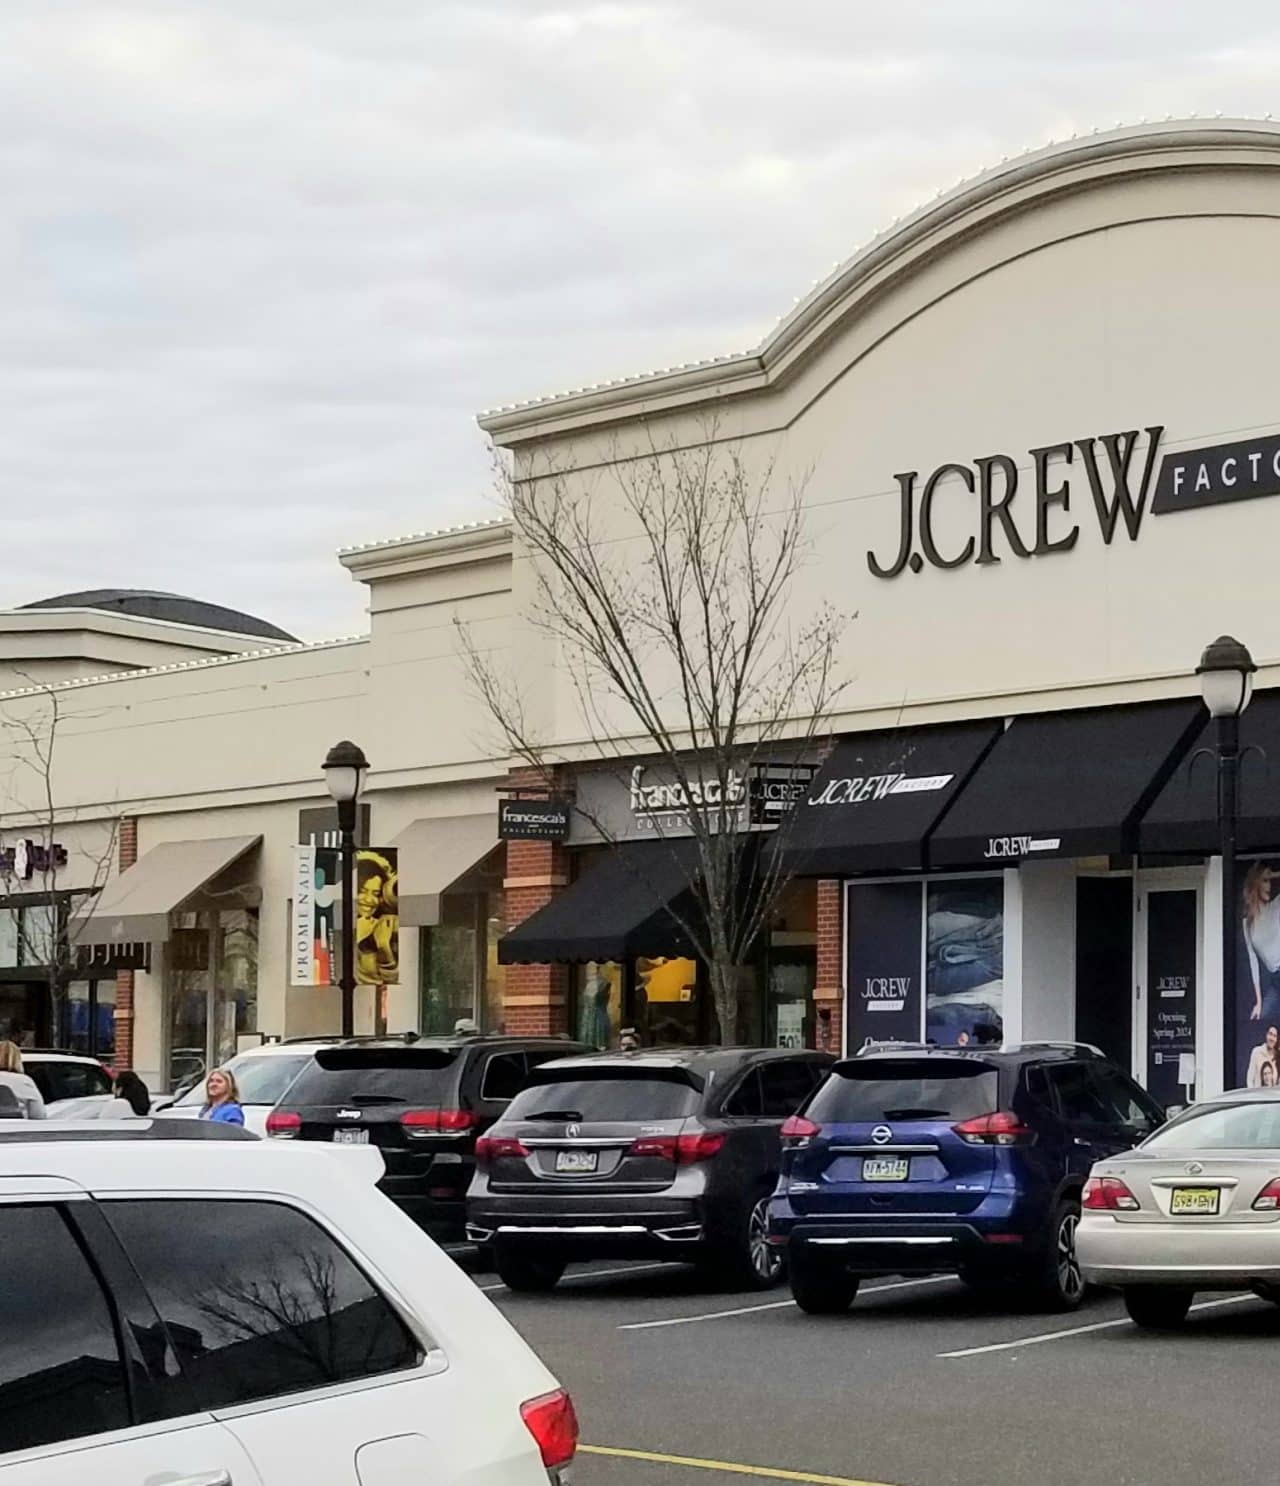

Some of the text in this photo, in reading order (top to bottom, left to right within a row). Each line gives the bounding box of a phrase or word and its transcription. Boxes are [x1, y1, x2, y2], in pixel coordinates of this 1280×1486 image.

[867, 426, 1165, 579] J.CREW
[808, 773, 906, 806] J.CREW
[502, 805, 566, 824] francesca's
[861, 977, 911, 998] J.CREW
